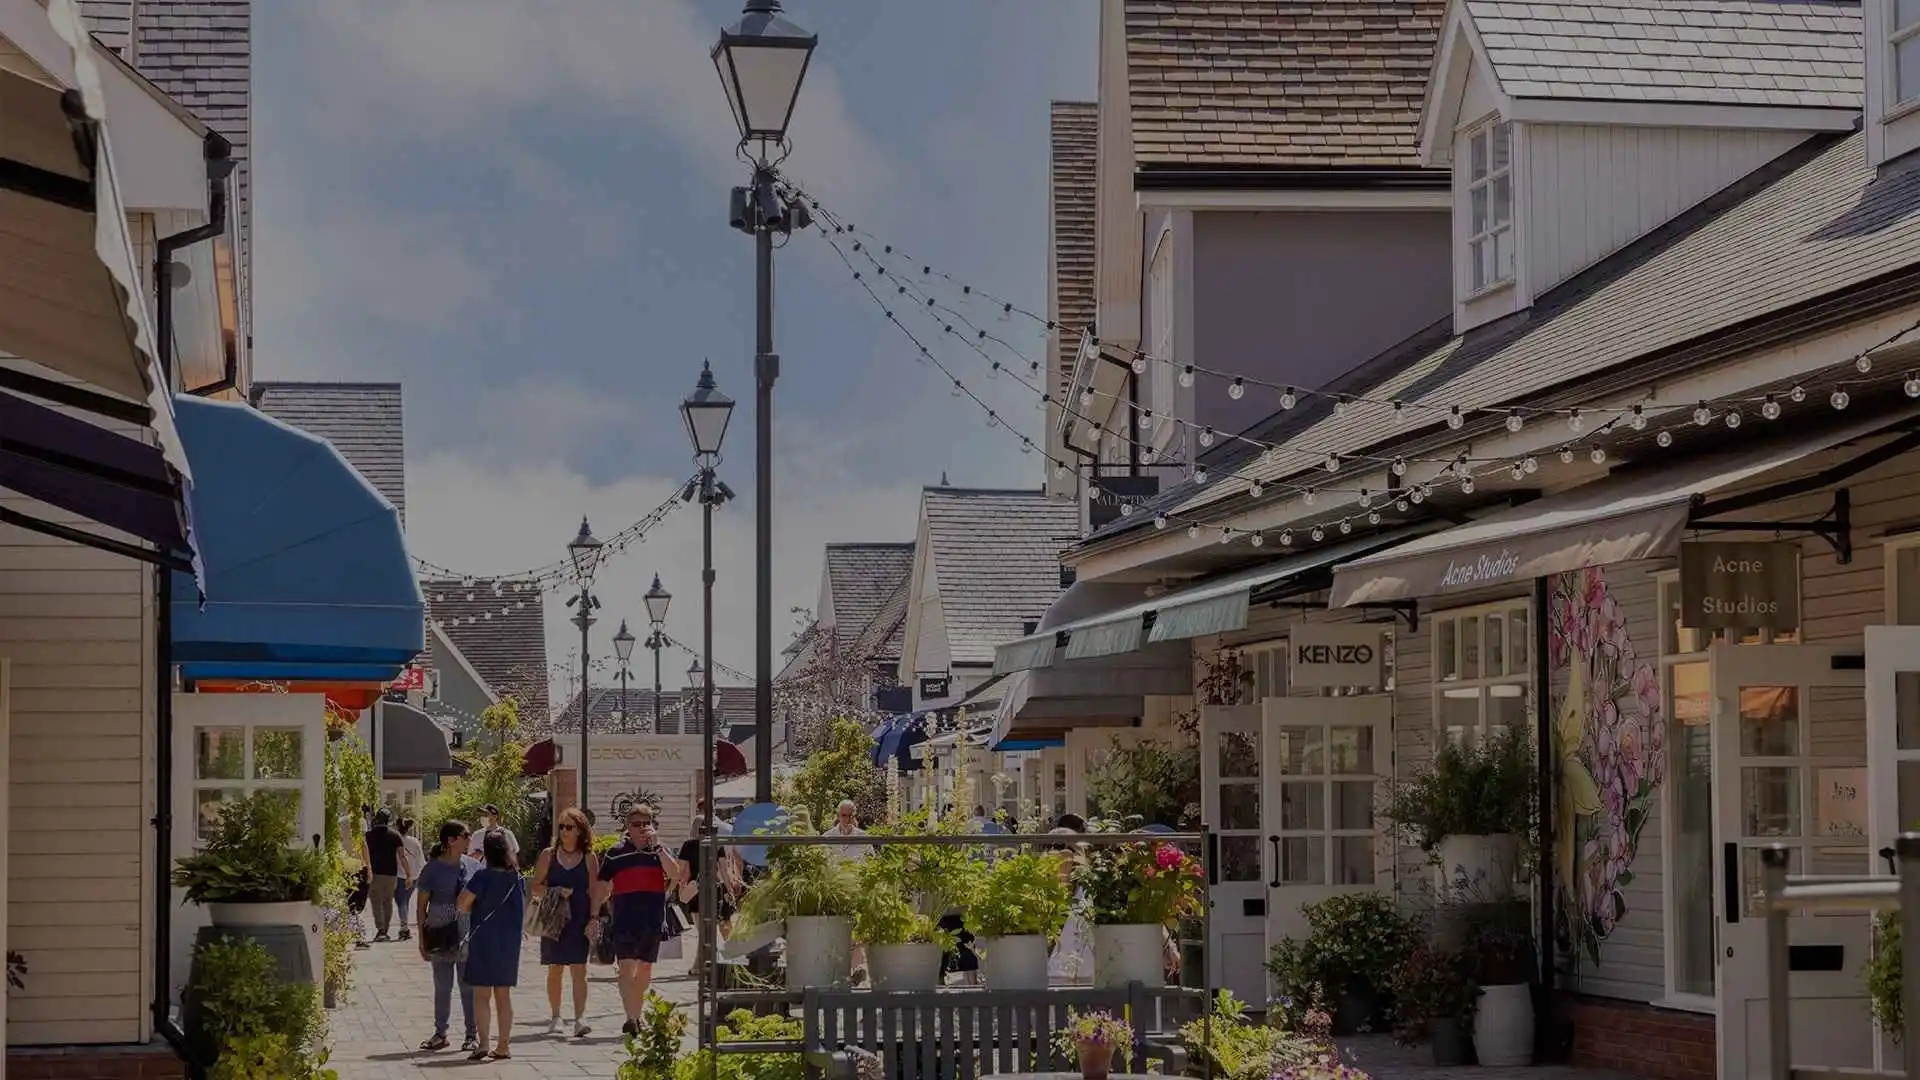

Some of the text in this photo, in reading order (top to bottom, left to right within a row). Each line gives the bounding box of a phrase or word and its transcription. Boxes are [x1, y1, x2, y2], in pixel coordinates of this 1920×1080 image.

[1441, 550, 1520, 587] Acne Studios
[1713, 555, 1763, 573] Acne
[1702, 592, 1778, 614] Studios
[1298, 644, 1373, 664] KENZO
